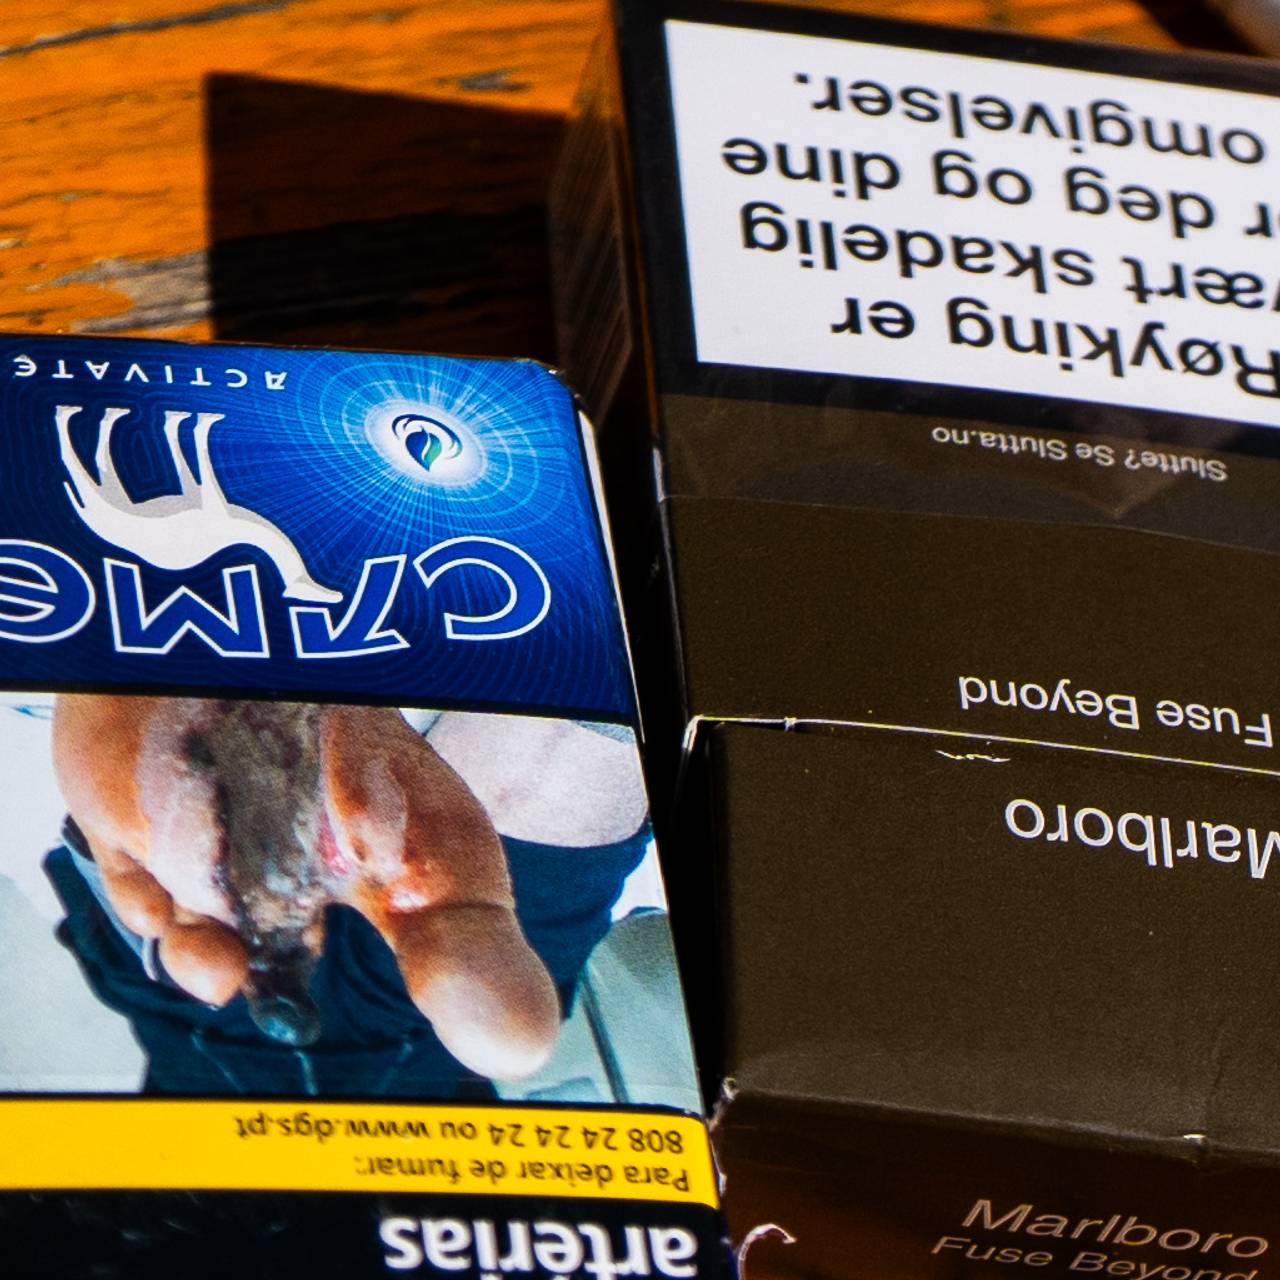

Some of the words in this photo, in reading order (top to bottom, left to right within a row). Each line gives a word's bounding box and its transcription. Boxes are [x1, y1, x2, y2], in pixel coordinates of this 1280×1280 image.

[794, 72, 1265, 165] omgivelser.
[721, 137, 901, 201] dine
[931, 148, 1033, 206] og
[1063, 165, 1215, 239] deg
[739, 200, 1094, 294] skadelig
[830, 296, 915, 339] er
[12, 354, 288, 390] ACTIVATE
[930, 426, 1068, 461] Slutta.no
[1074, 441, 1115, 467] Se
[1123, 447, 1227, 482] Slutte?
[957, 675, 1140, 730] Beyond
[1155, 699, 1274, 748] Fuse
[234, 1111, 430, 1141] www.dgs.pt
[439, 1120, 477, 1140] ou
[487, 1122, 525, 1147] 24
[534, 1124, 571, 1149] 24
[580, 1126, 618, 1151] 24
[627, 1127, 683, 1154] 808
[356, 1156, 461, 1184] fumar:
[469, 1158, 506, 1184] de
[519, 1160, 613, 1188] deixar
[622, 1164, 690, 1193] Para
[960, 1198, 1269, 1258] Marlboro
[930, 1235, 1053, 1266] Fuse
